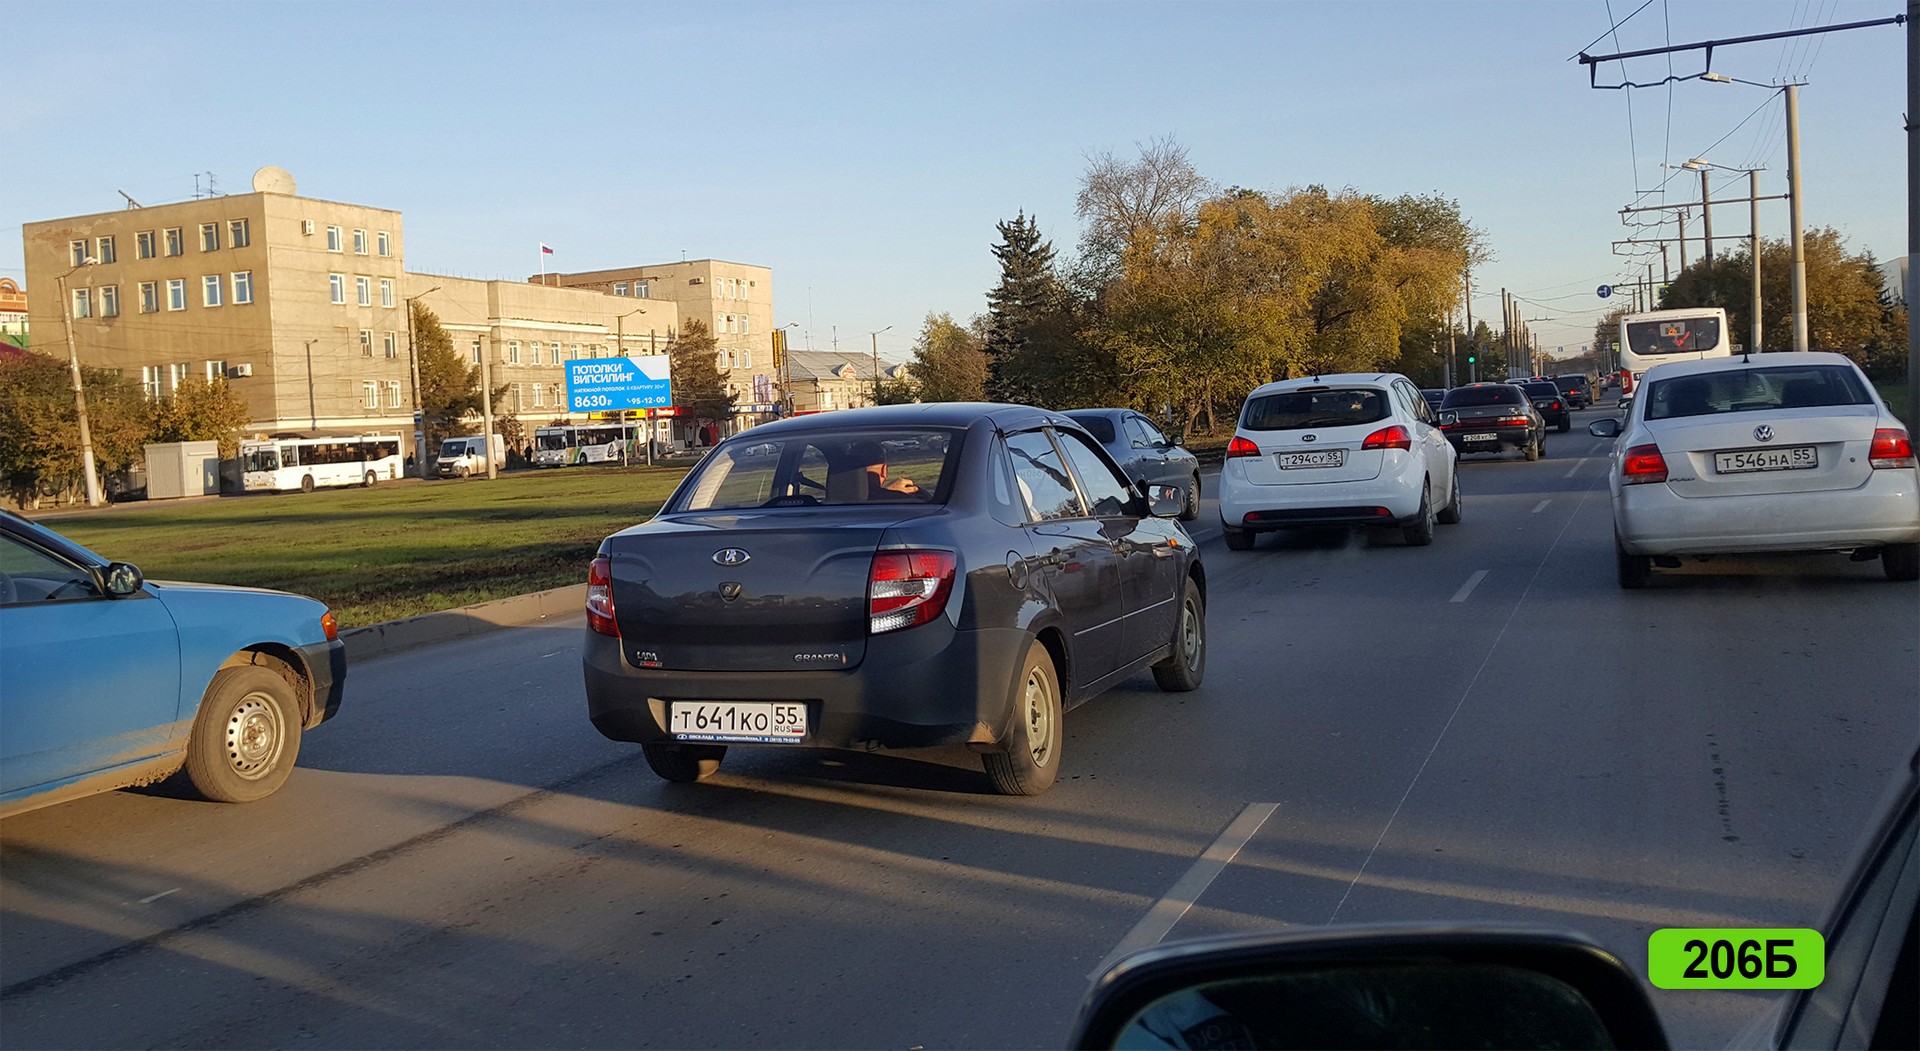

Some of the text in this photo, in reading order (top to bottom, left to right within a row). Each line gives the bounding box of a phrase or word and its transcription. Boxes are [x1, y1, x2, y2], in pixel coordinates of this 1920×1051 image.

[572, 364, 622, 375] ПОТОЛКИ
[573, 373, 635, 384] ВИПСИЛИНГ
[1327, 452, 1338, 460] 55
[1793, 449, 1811, 460] 55
[636, 651, 657, 660] LADA
[794, 653, 839, 661] GRANTA
[681, 705, 798, 731] Т641КО 55
[774, 725, 791, 733] RUS
